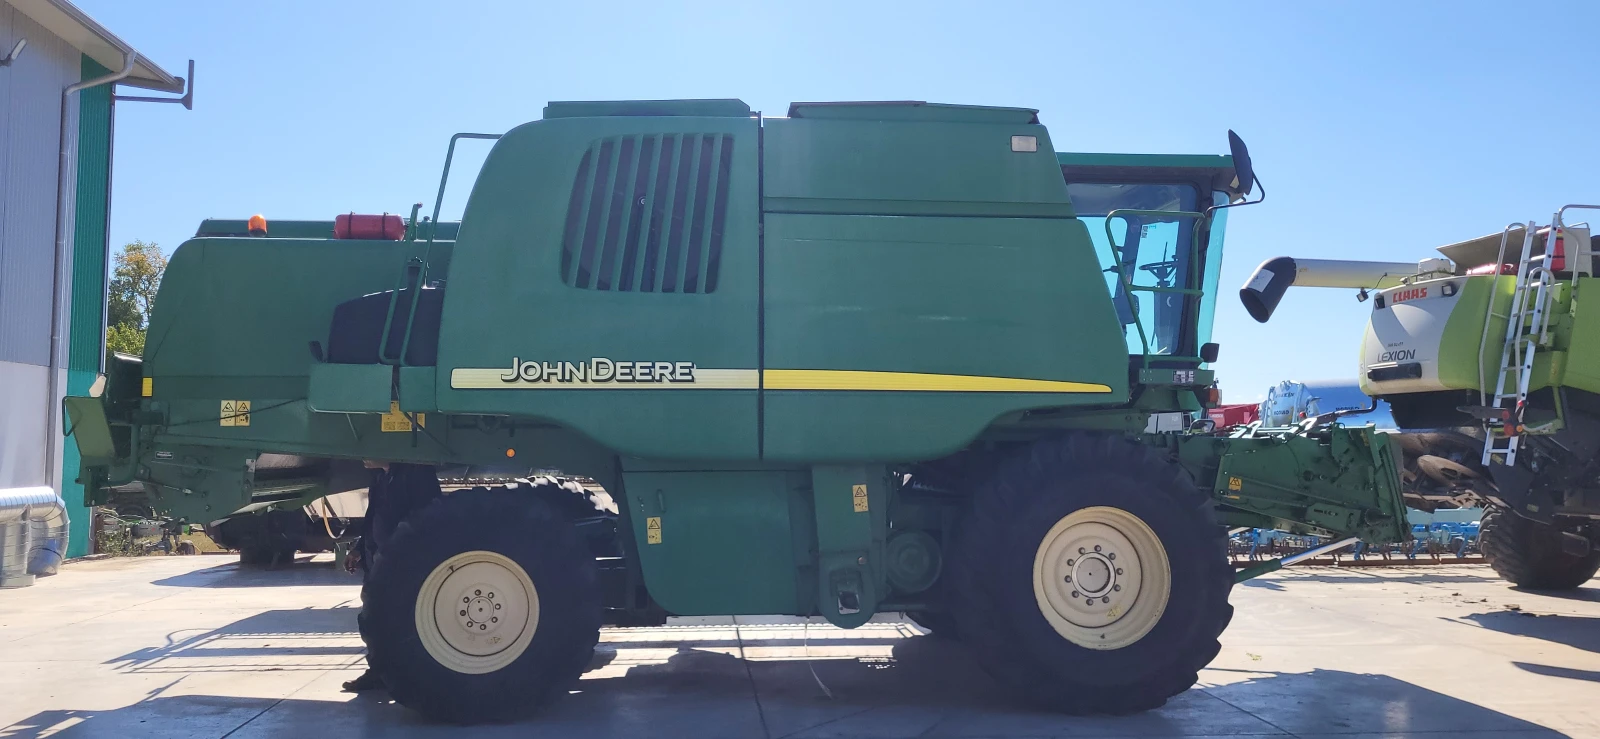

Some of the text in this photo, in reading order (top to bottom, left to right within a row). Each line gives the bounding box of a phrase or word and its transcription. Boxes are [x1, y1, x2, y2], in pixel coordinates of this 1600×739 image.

[1392, 287, 1428, 303] CLAAS
[1377, 349, 1416, 363] LEXION
[501, 356, 695, 383] JOHN DEERE
